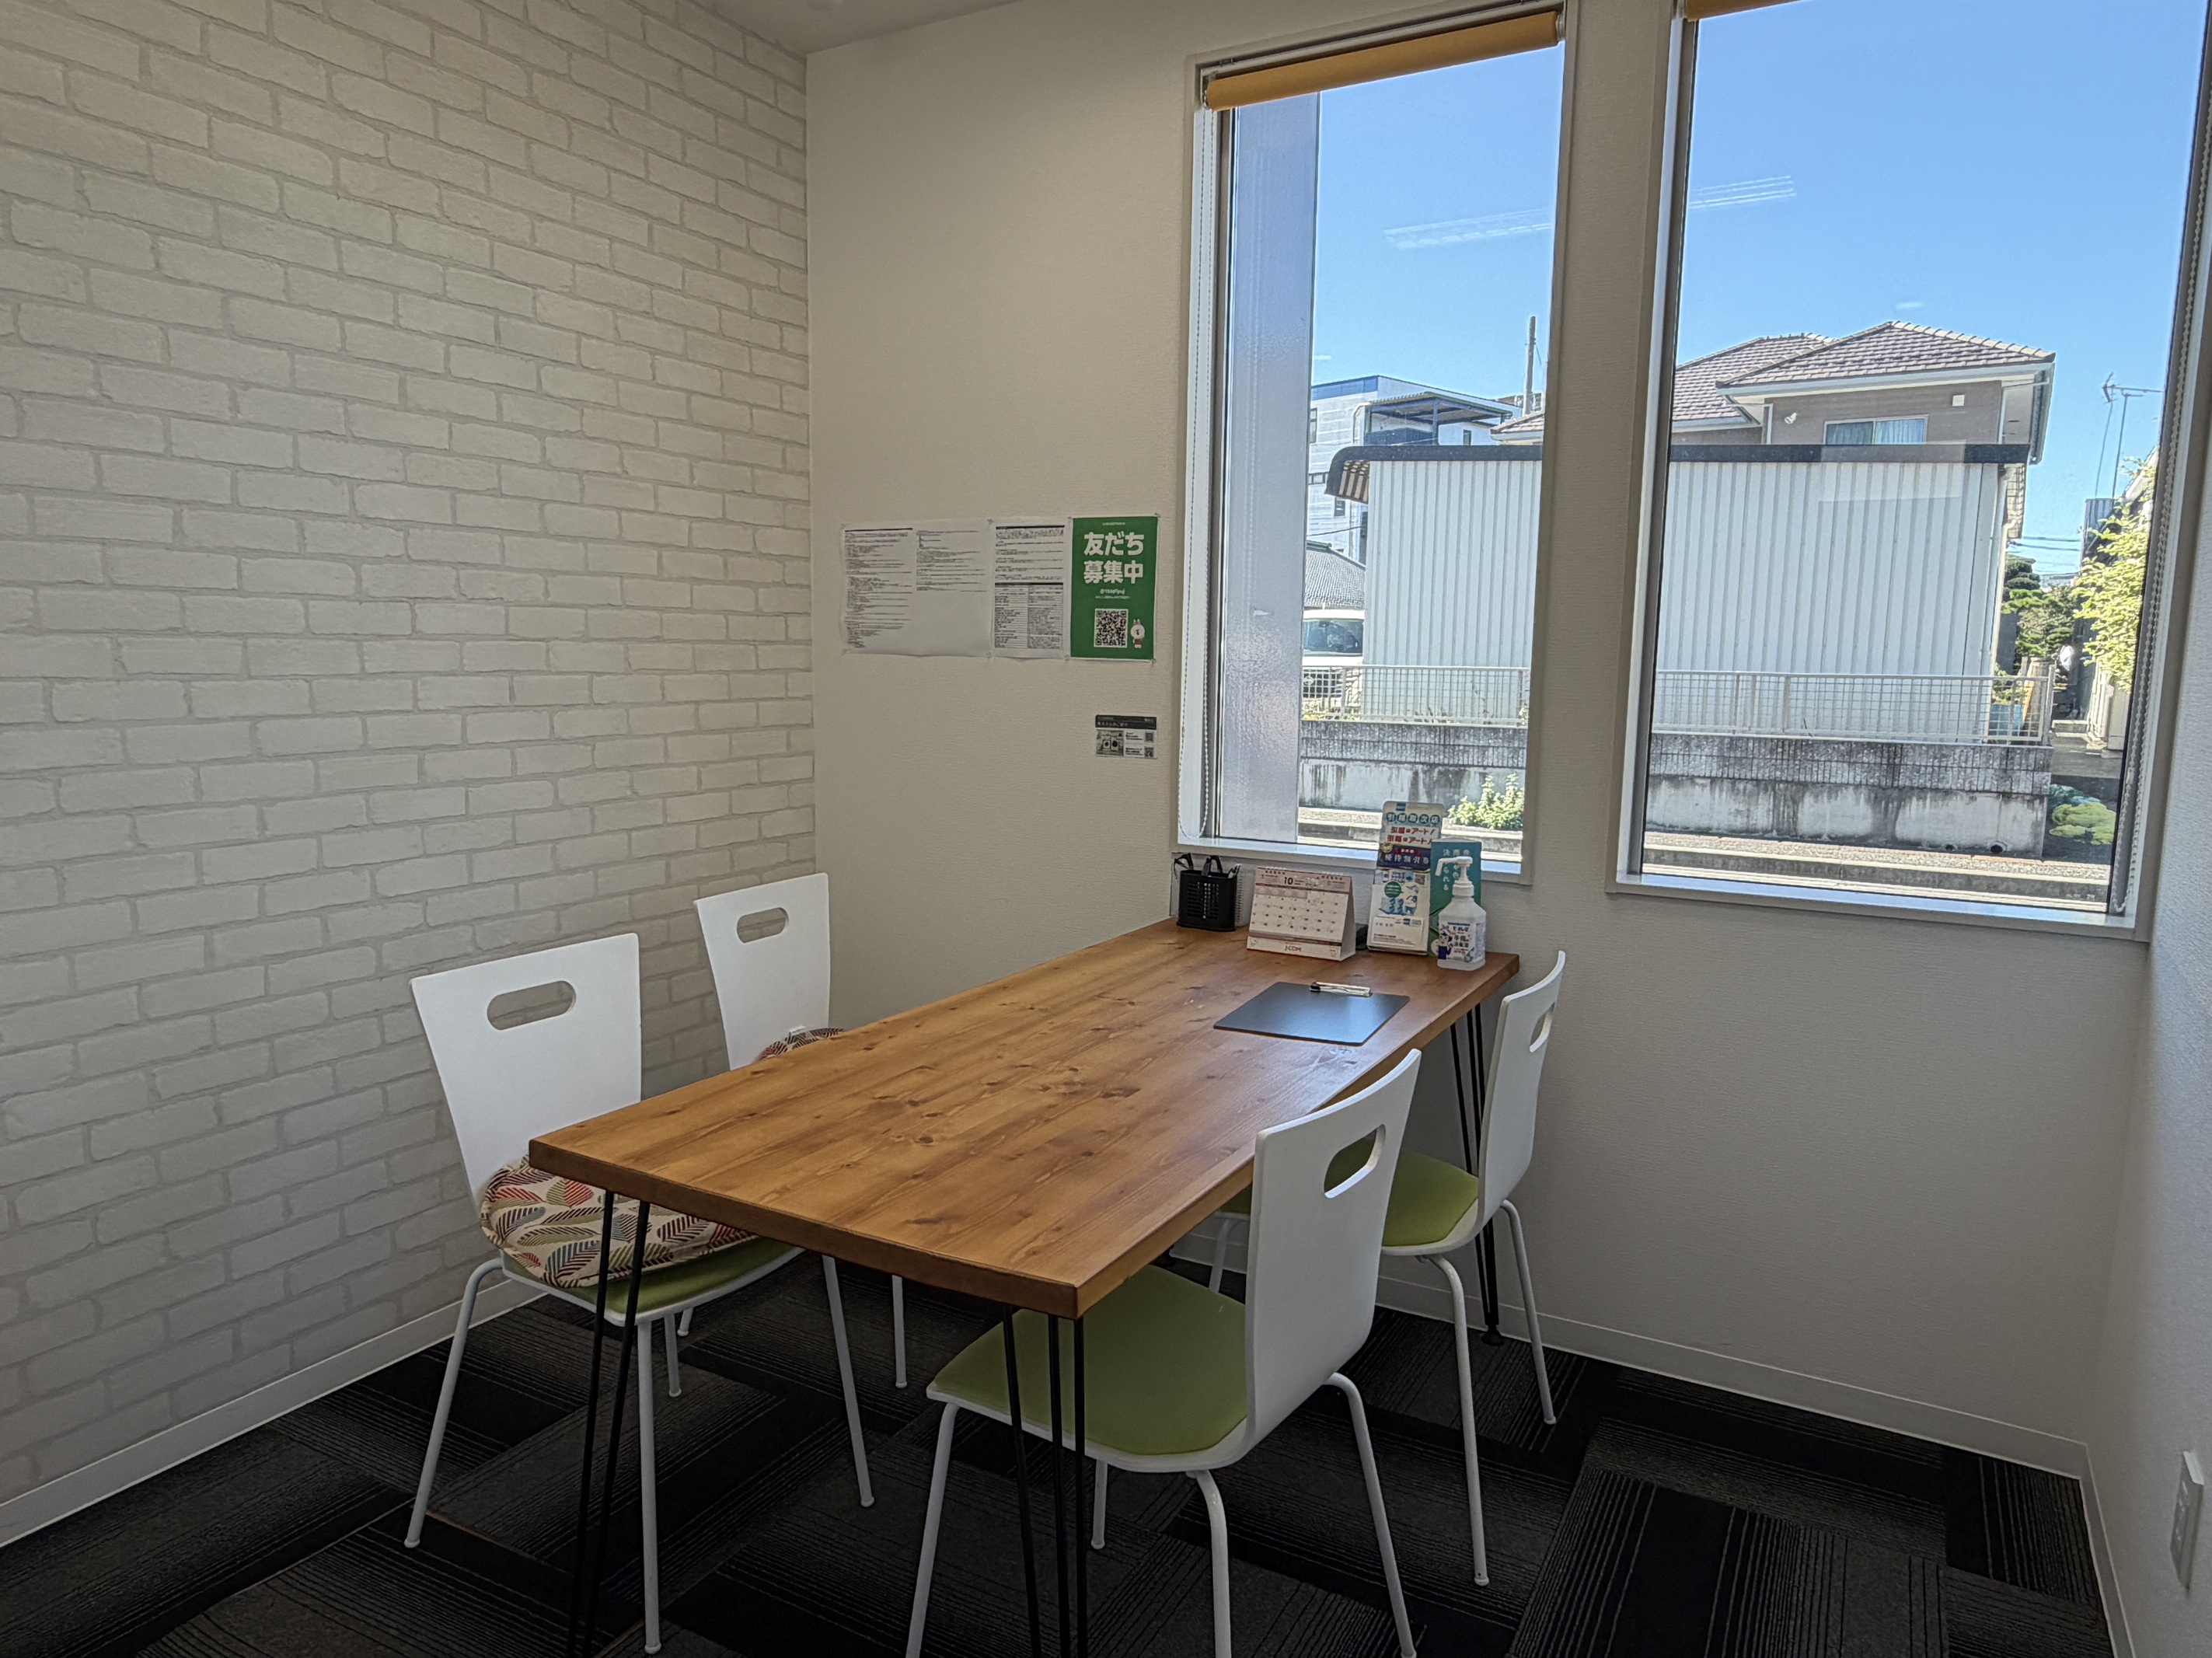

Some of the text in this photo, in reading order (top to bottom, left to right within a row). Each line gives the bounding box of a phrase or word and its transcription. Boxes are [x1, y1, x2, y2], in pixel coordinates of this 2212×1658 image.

[1083, 531, 1144, 556] 友だち
[1083, 560, 1144, 584] 募集中
[1283, 876, 1294, 885] 10
